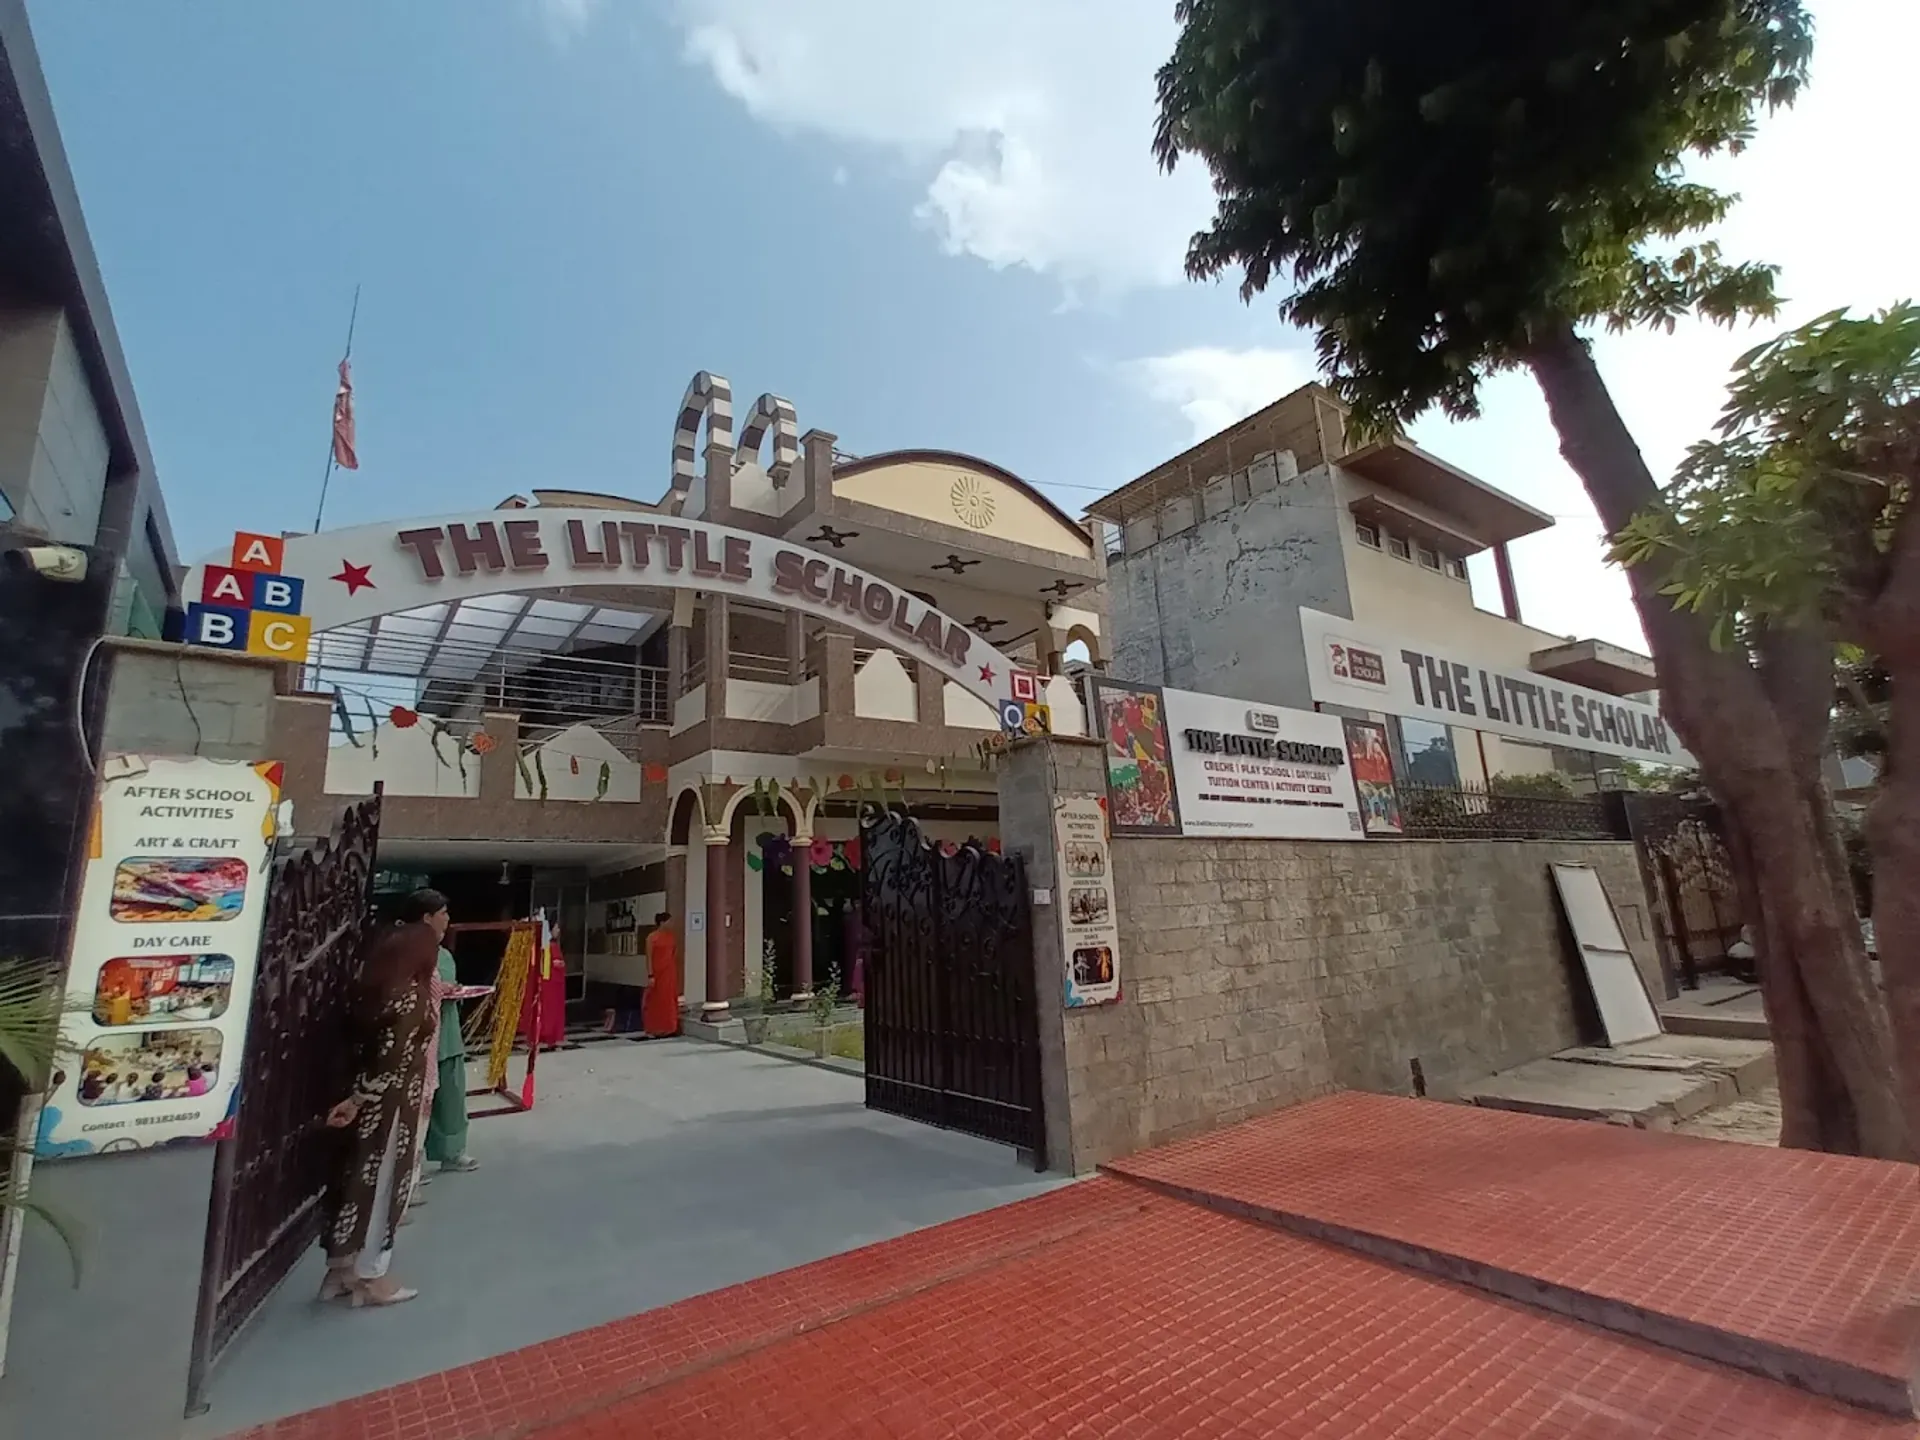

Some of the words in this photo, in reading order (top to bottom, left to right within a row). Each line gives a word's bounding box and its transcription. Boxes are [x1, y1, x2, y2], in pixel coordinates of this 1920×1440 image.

[241, 540, 272, 566] A
[212, 575, 244, 600] A
[265, 581, 292, 606] B
[397, 520, 549, 581] THE
[566, 518, 752, 581] LITTLE
[773, 549, 972, 667] SCHOLAR
[200, 613, 234, 643] B
[263, 622, 295, 651] C
[1401, 649, 1477, 716] THE
[1479, 670, 1572, 735] LITTLE
[1573, 694, 1672, 755] SCHOLAR
[1184, 728, 1222, 752] THE
[1223, 733, 1275, 759] LITTLE
[1276, 740, 1345, 765] SCHOLAR
[1204, 760, 1235, 773] CRECHE
[1241, 764, 1261, 775] PLAY
[1263, 766, 1291, 778] SCHOOL
[1296, 769, 1327, 781] DAYCARE
[124, 786, 181, 799] AFTER
[185, 788, 255, 802] SCHOOL
[1208, 776, 1240, 788] TUITION
[1242, 779, 1270, 791] CENTER
[1276, 782, 1306, 793] ACTIVITY
[1308, 785, 1332, 795] CENTER
[140, 806, 234, 819] ACTIVITIES
[134, 837, 169, 848] ART
[172, 838, 184, 848] &
[188, 838, 240, 849] CRAFT
[133, 937, 166, 948] DAY
[169, 936, 212, 947] CARE
[82, 1120, 125, 1132] Contact
